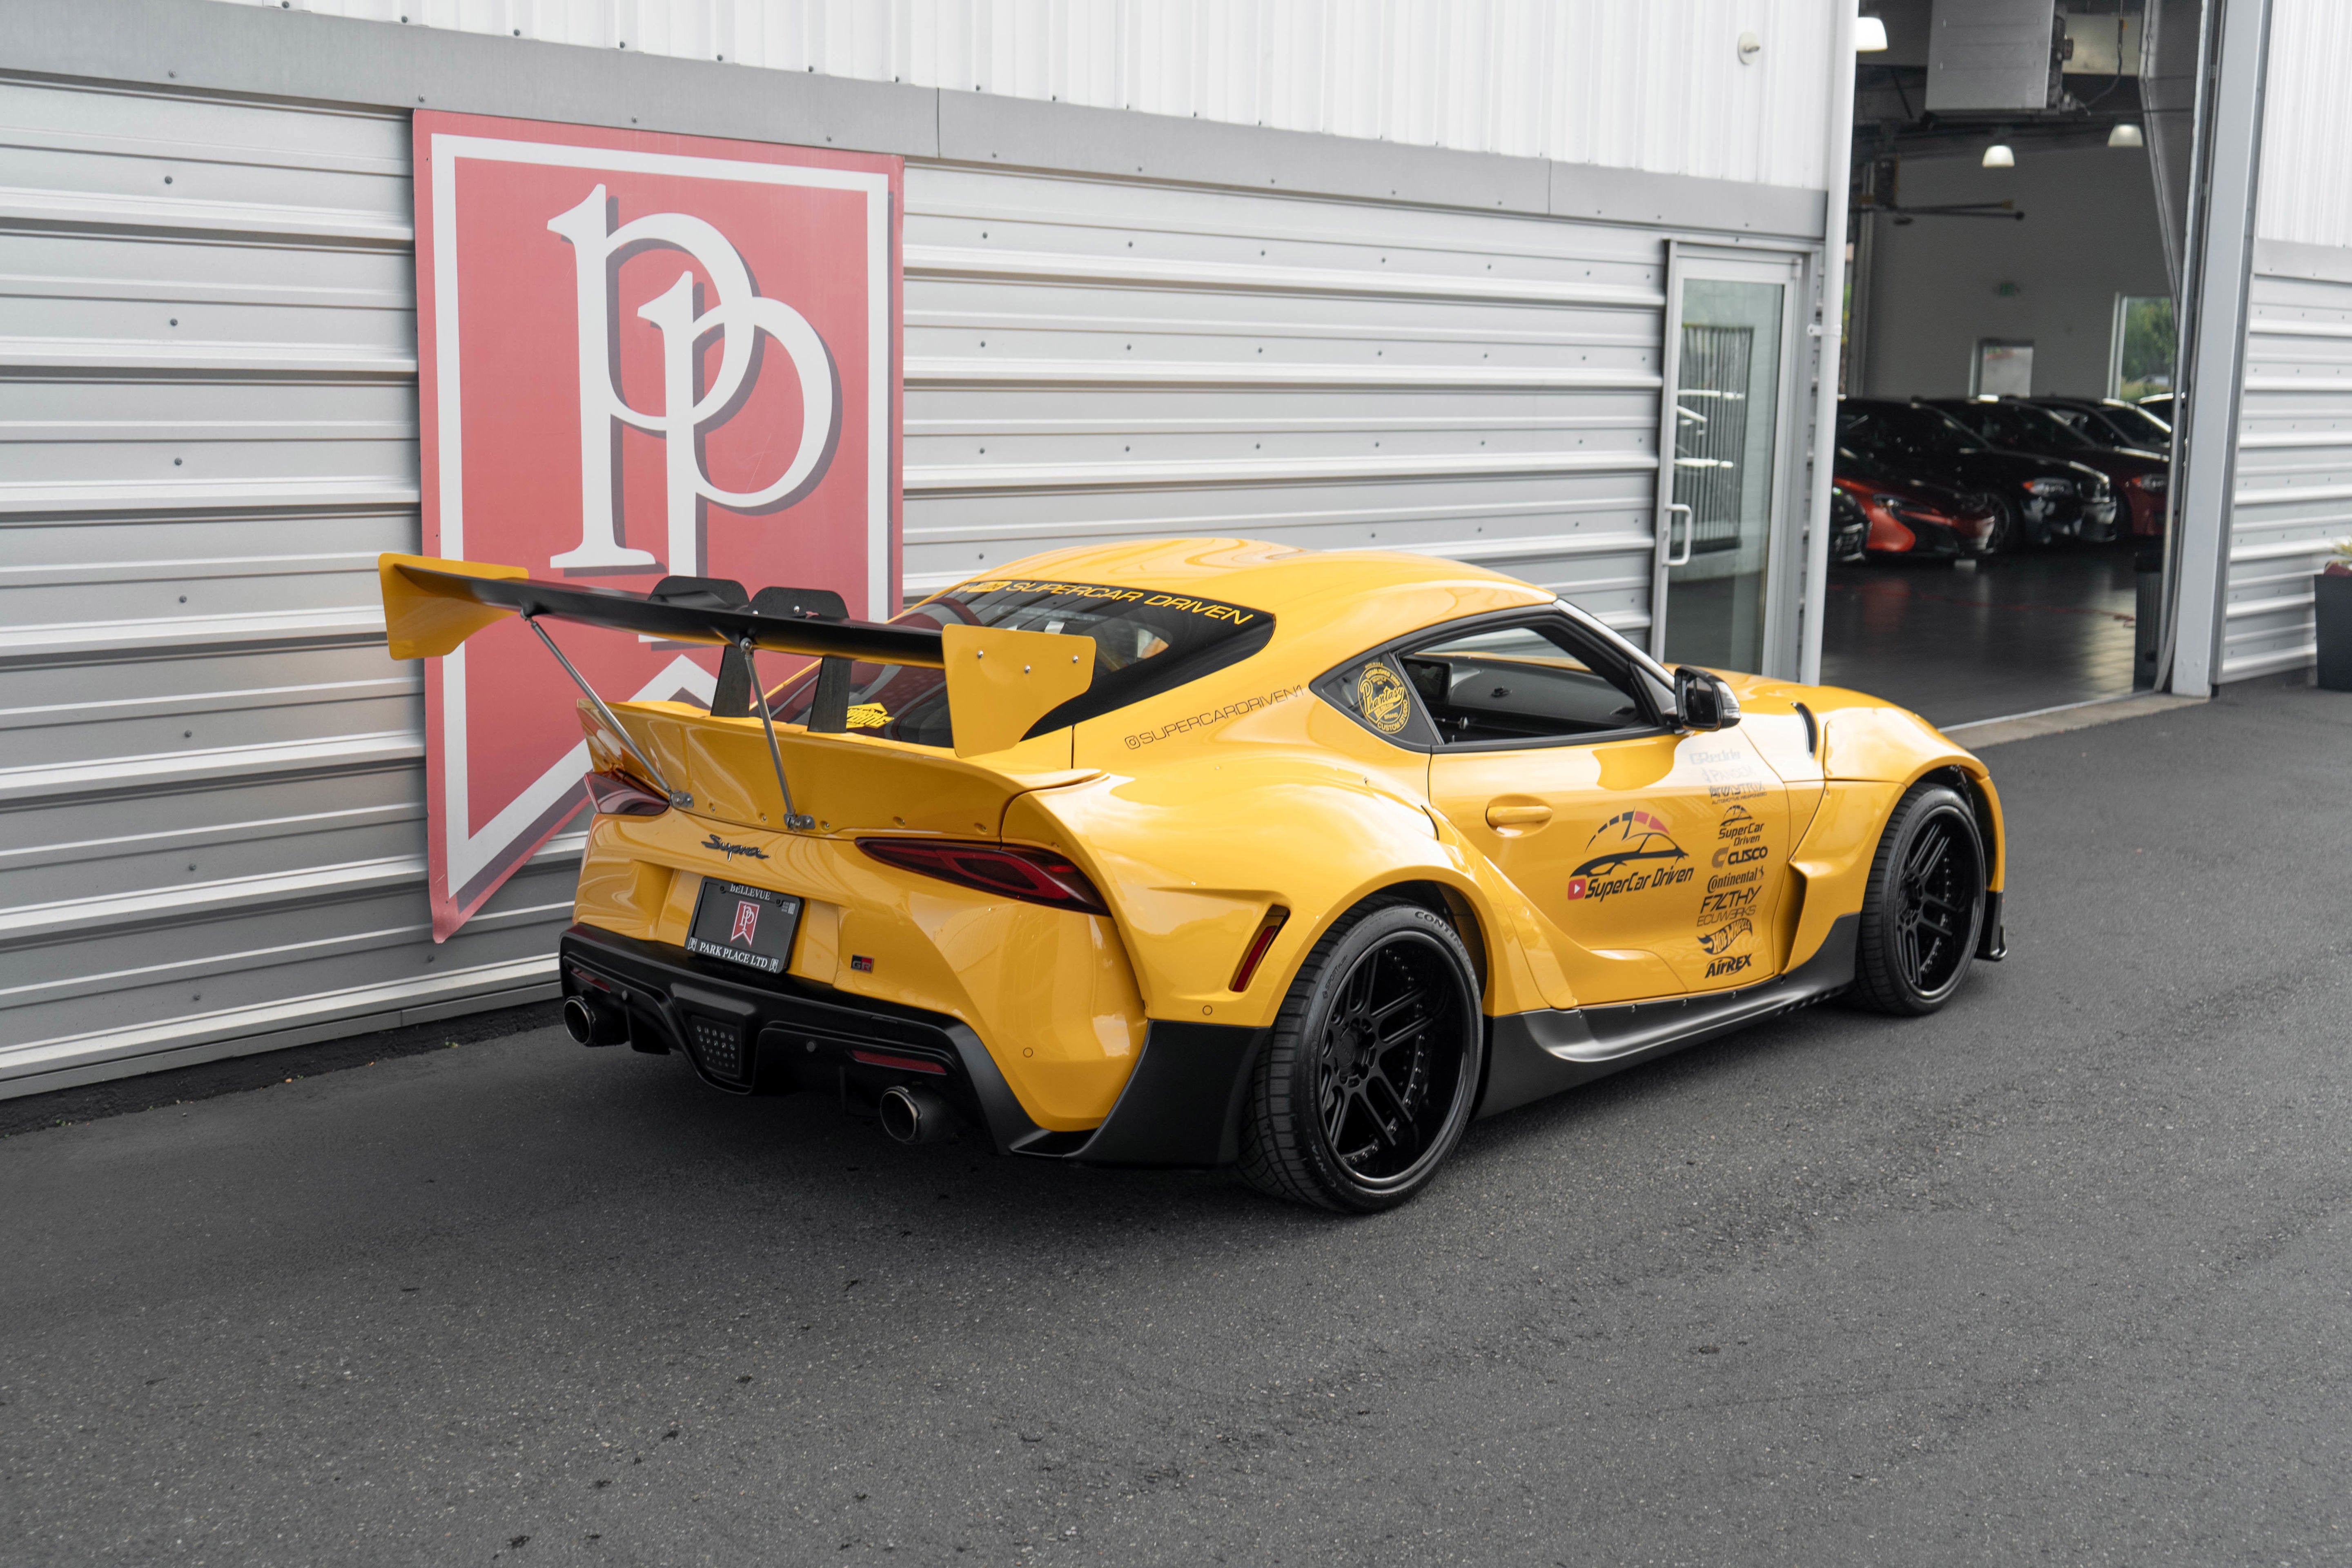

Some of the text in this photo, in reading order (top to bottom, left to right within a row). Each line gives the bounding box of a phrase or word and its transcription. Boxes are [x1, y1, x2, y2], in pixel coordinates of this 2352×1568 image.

[1006, 582, 1144, 602] SUPERCAR
[1144, 594, 1254, 625] DRIVEN
[1360, 679, 1404, 715] Phantasy
[1377, 721, 1401, 731] CUSTOM
[1399, 699, 1408, 726] STUDIO
[1718, 822, 1765, 840] SuperCar
[1733, 835, 1760, 846] Driven
[701, 834, 771, 862] Supra
[1728, 846, 1768, 865] CUSCO
[730, 883, 771, 901] BELLEVUE
[1585, 865, 1694, 902] SuperCar Driven
[1707, 867, 1758, 893] Continental
[699, 942, 723, 957] PARK
[722, 947, 750, 964] PLACE
[750, 956, 768, 969] LTD
[852, 960, 871, 972] GR
